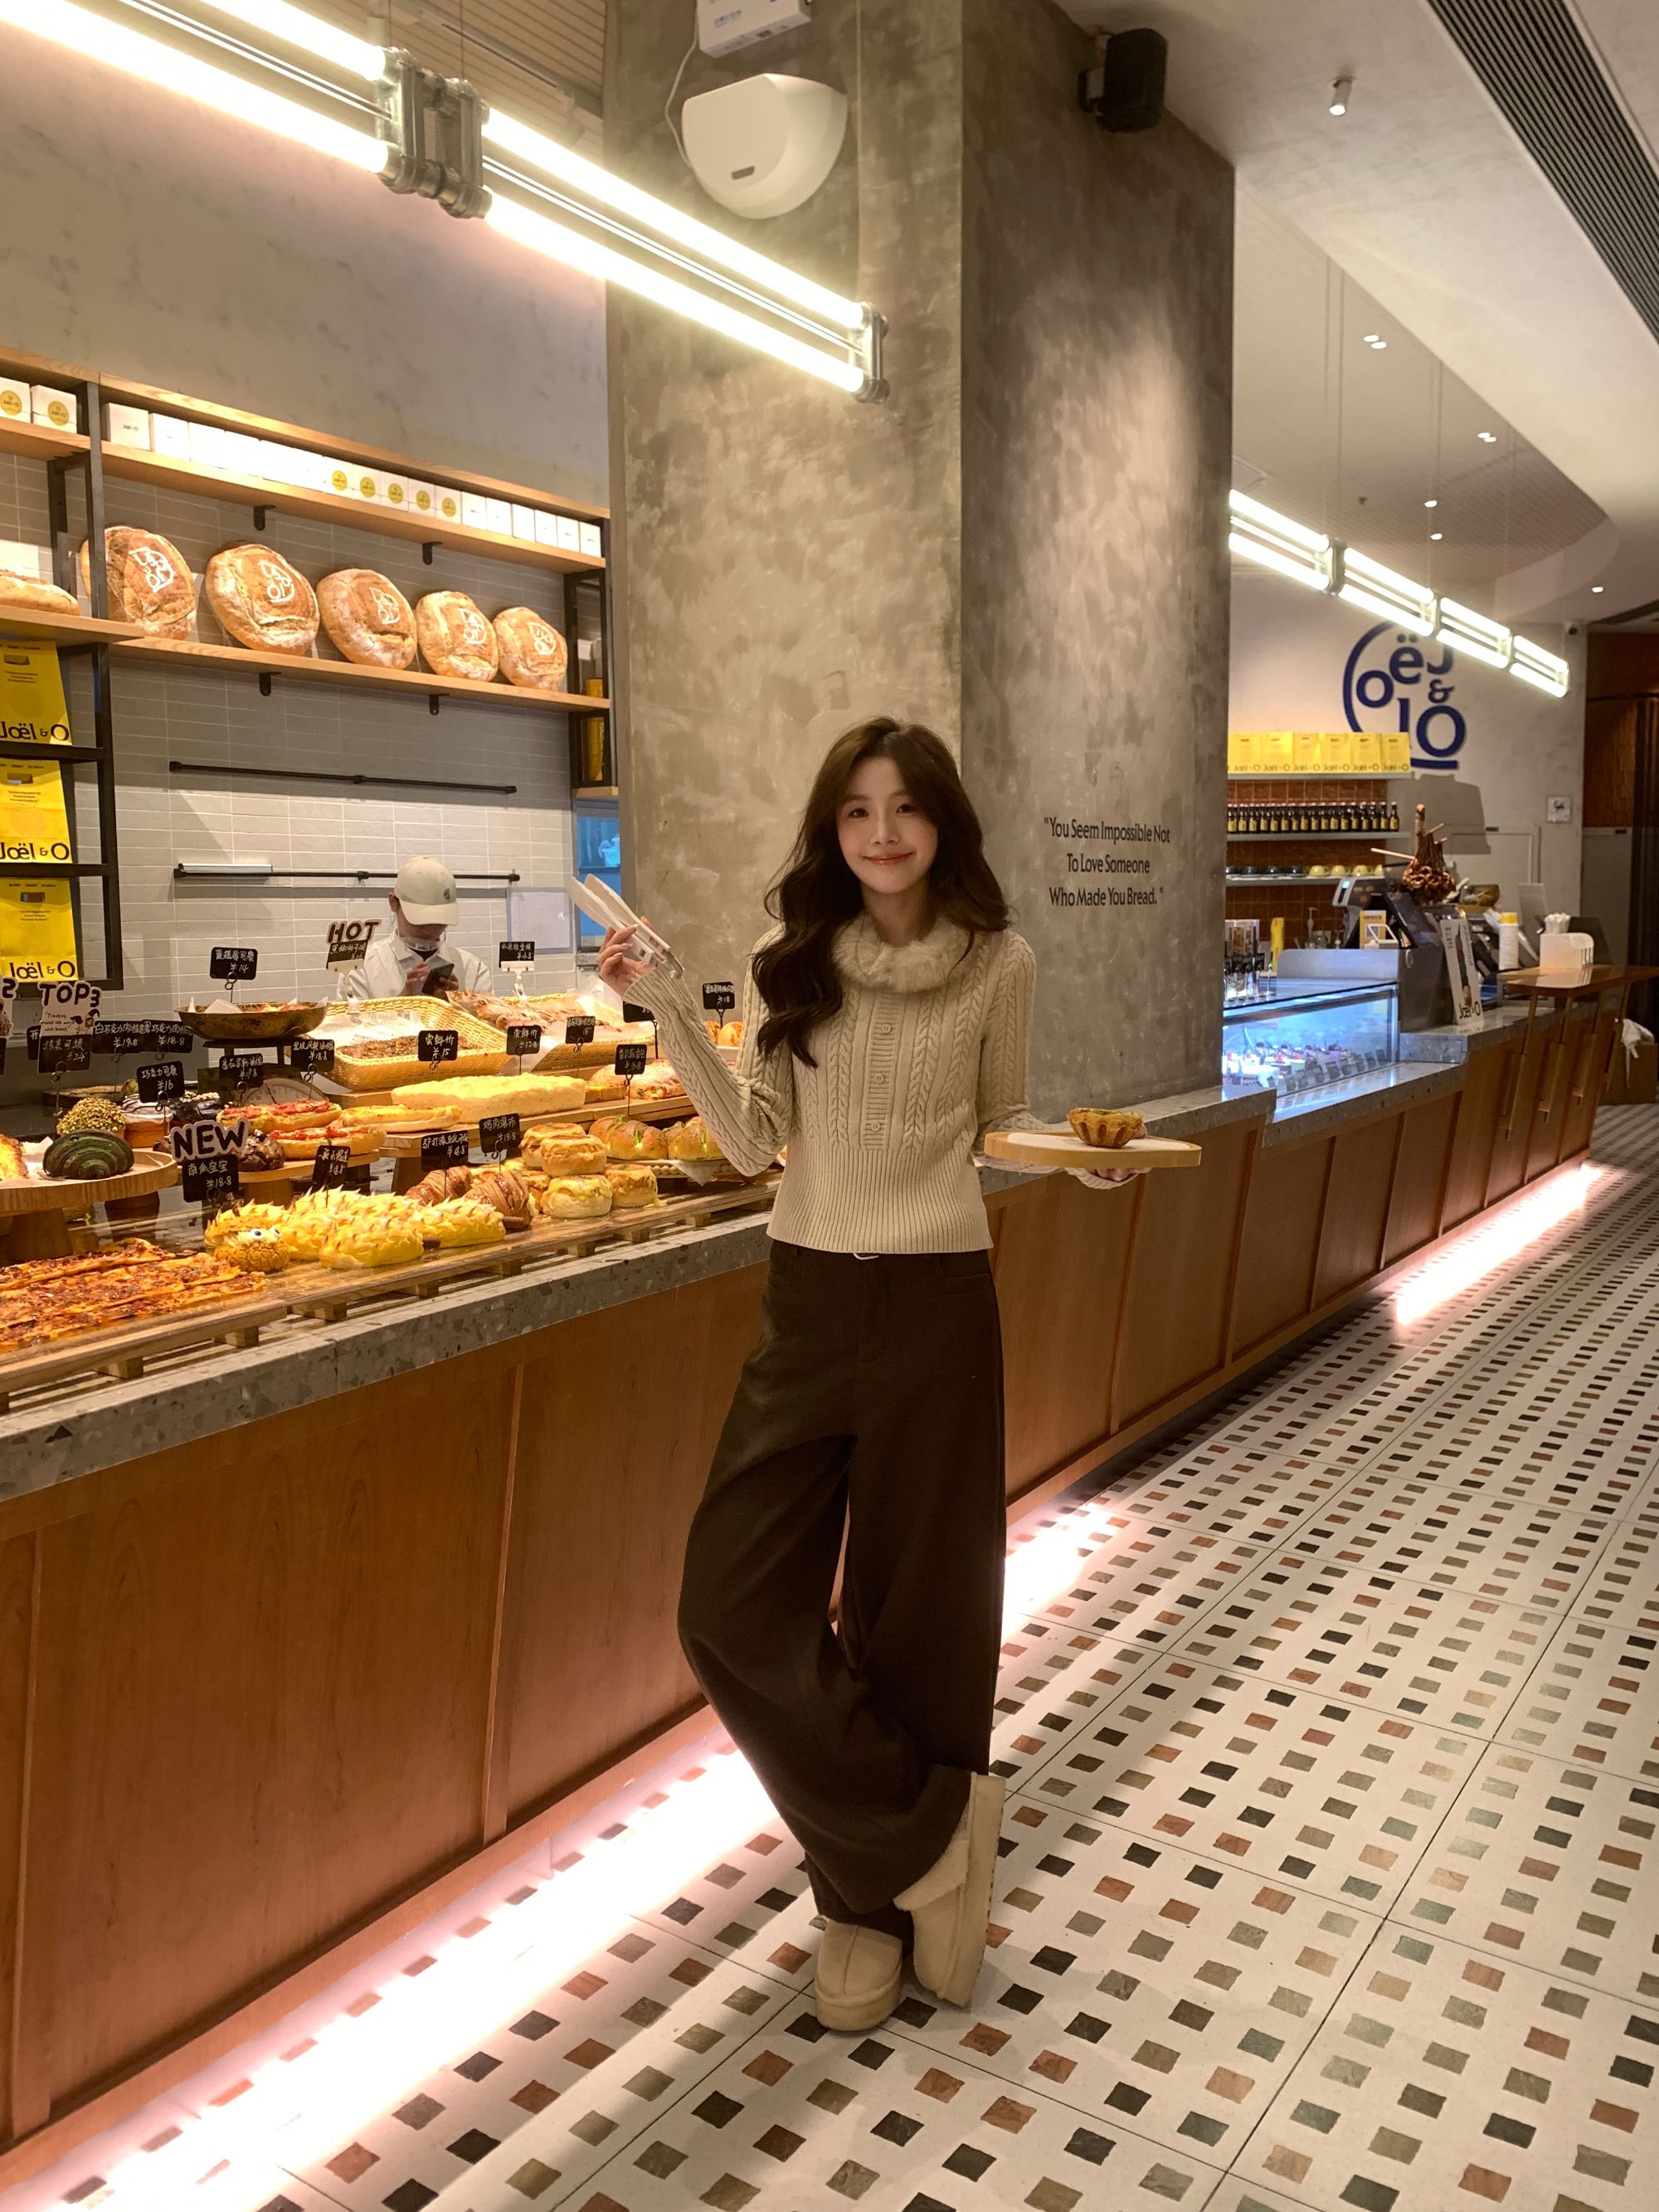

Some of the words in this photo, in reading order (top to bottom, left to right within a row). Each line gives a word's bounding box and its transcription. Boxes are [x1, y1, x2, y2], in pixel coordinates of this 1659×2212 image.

[0, 721, 37, 740] Joël
[40, 728, 48, 737] &
[50, 724, 69, 741] O
[1071, 819, 1099, 839] Seem
[1101, 821, 1152, 845] Impossible
[1154, 826, 1170, 843] Not
[0, 842, 36, 860] Joël
[40, 847, 48, 856] &
[51, 842, 70, 860] O
[1067, 853, 1078, 872] To
[1081, 853, 1103, 872] Love
[1105, 854, 1150, 874] Someone
[1049, 887, 1075, 906] Who
[1077, 887, 1106, 906] Made
[1107, 887, 1125, 905] You
[328, 922, 379, 943] HOT
[46, 966, 56, 974] &
[57, 961, 75, 977] O
[173, 1121, 246, 1159] NEW
